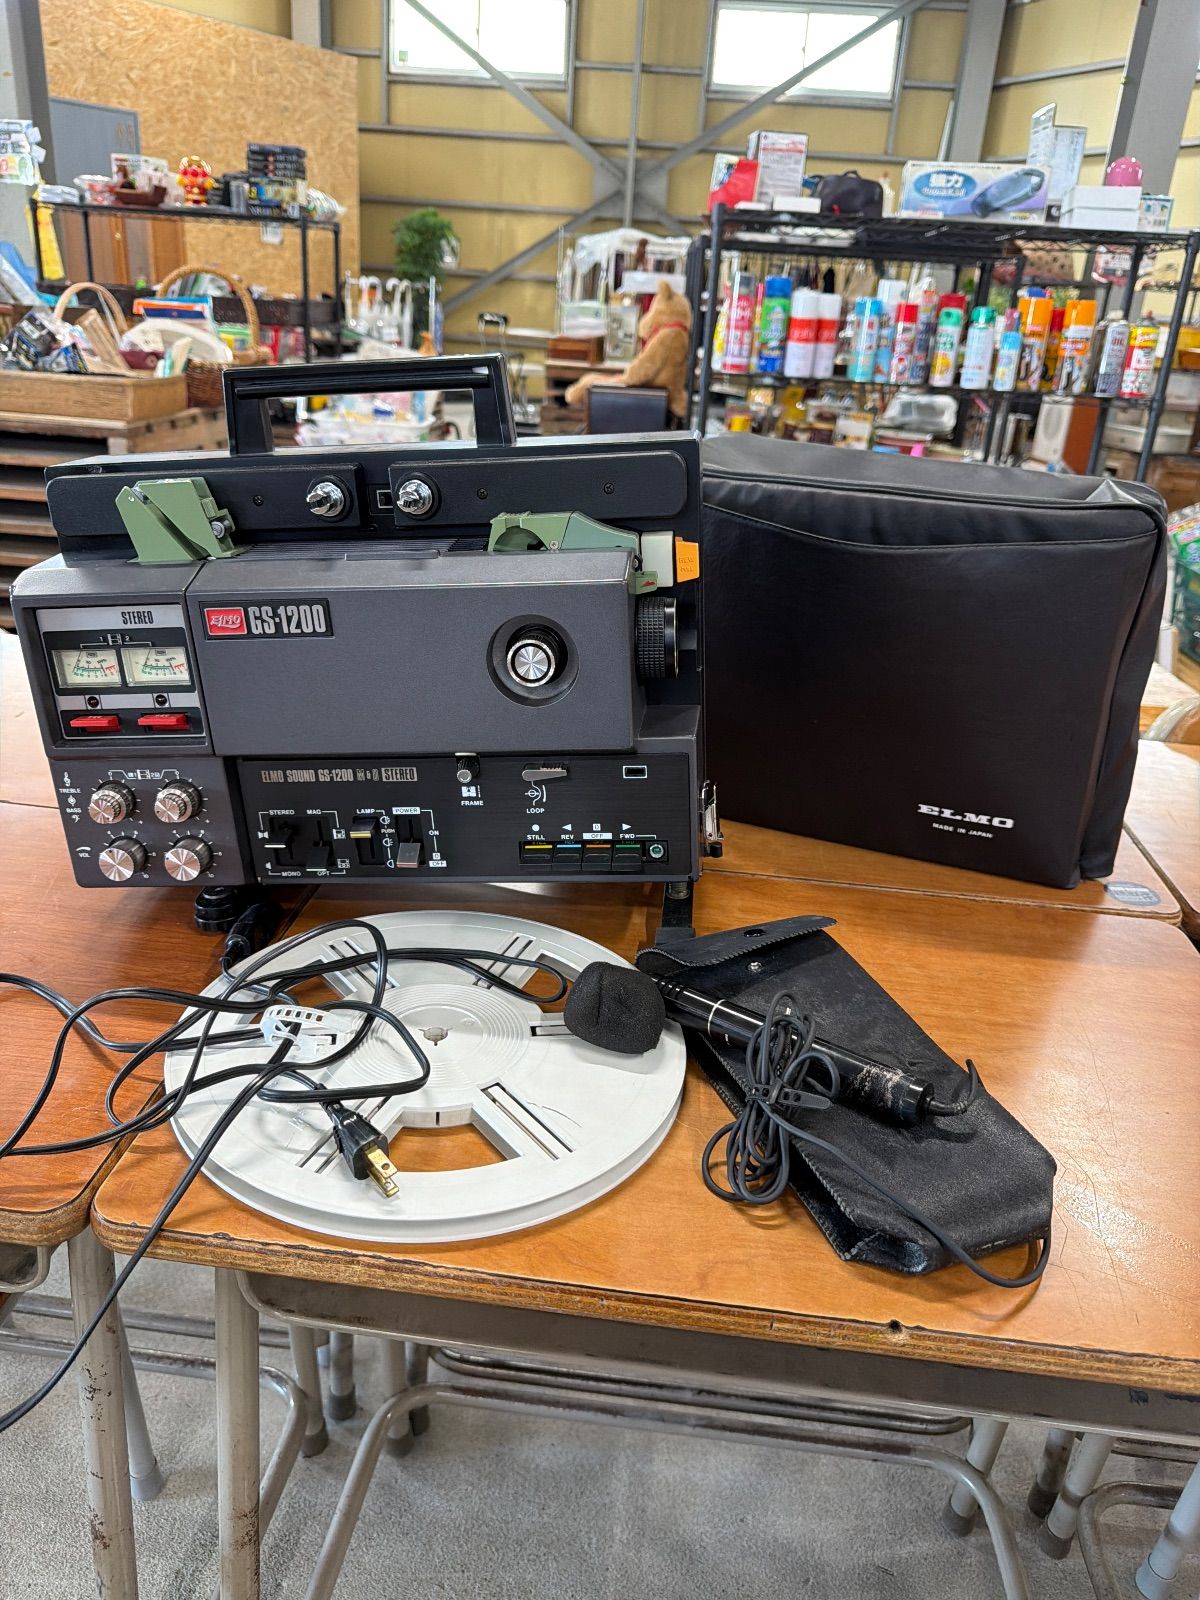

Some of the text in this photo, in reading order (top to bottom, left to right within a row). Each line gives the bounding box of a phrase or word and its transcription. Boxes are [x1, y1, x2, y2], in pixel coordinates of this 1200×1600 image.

[121, 610, 154, 625] STEREO
[247, 604, 327, 635] GS-1200
[261, 770, 284, 783] ELMO
[286, 769, 316, 782] SOUND
[318, 768, 354, 782] GS-1200
[383, 767, 416, 781] STEREO
[917, 803, 1015, 829] ELMO
[932, 822, 954, 832] MADE
[968, 829, 993, 839] JAPAN
